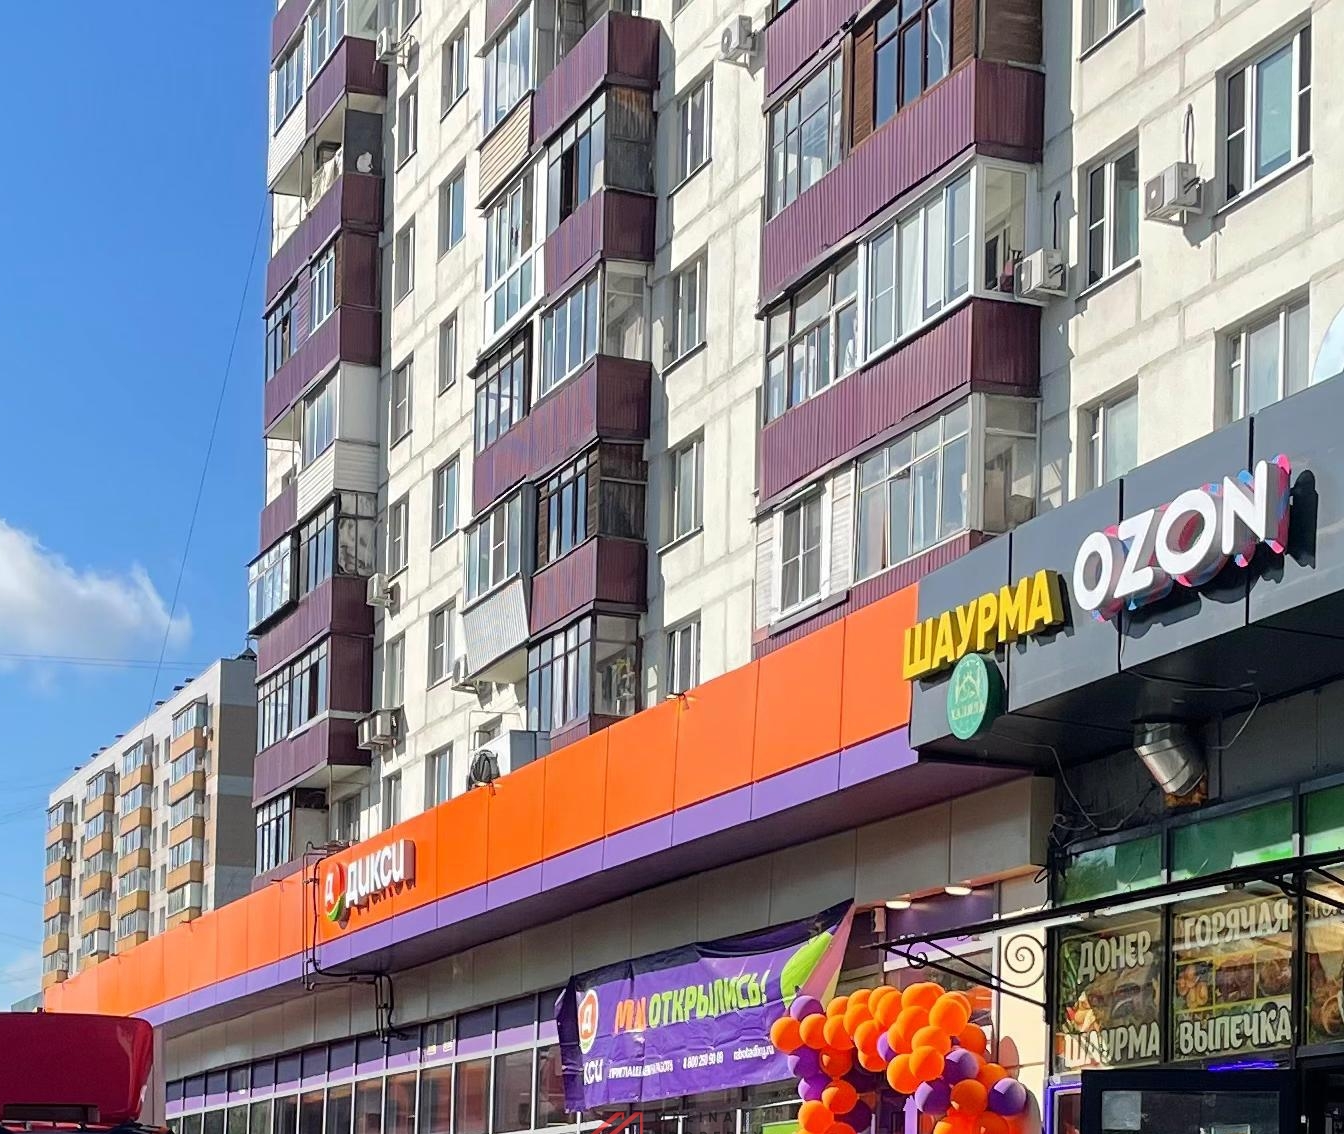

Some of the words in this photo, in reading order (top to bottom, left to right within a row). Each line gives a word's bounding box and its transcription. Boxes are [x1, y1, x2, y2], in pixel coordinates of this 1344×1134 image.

[1073, 456, 1286, 614] OZON
[903, 569, 1058, 681] ШАУРМА
[1183, 900, 1290, 950] ГОРЯЧАЯ
[1078, 930, 1152, 984] ДОНЕР
[648, 970, 770, 1029] ОТКРЫЛИСЬ!
[1064, 1021, 1161, 1068] ШАУРМА
[1179, 1007, 1292, 1055] ВЫПЕЧКА
